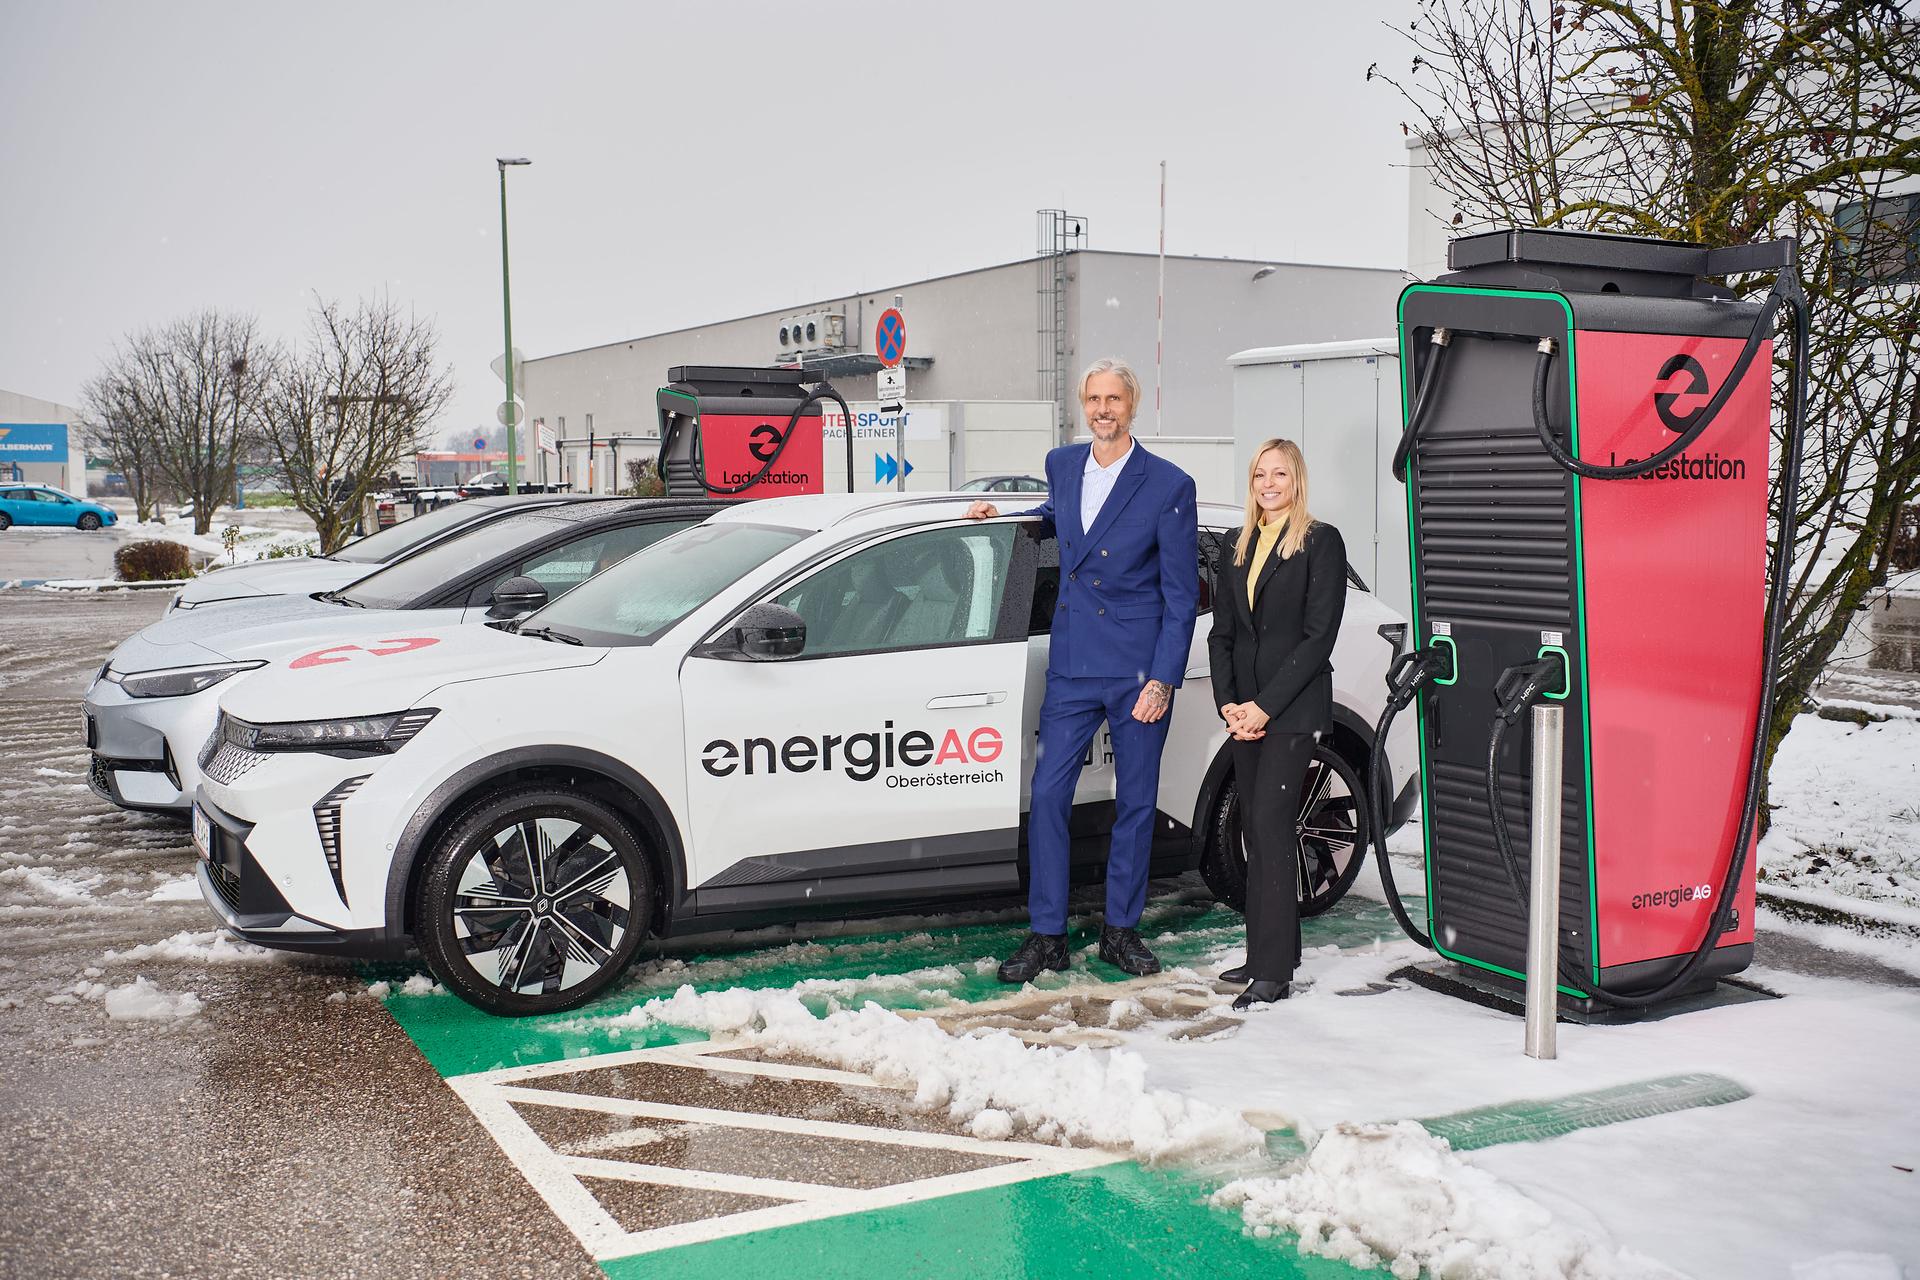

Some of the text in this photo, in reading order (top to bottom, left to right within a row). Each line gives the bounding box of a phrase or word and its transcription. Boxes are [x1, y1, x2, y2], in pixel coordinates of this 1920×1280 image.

[1410, 669, 1425, 687] HPC
[1520, 682, 1536, 701] HPC
[886, 769, 1004, 788] Oberösterreich
